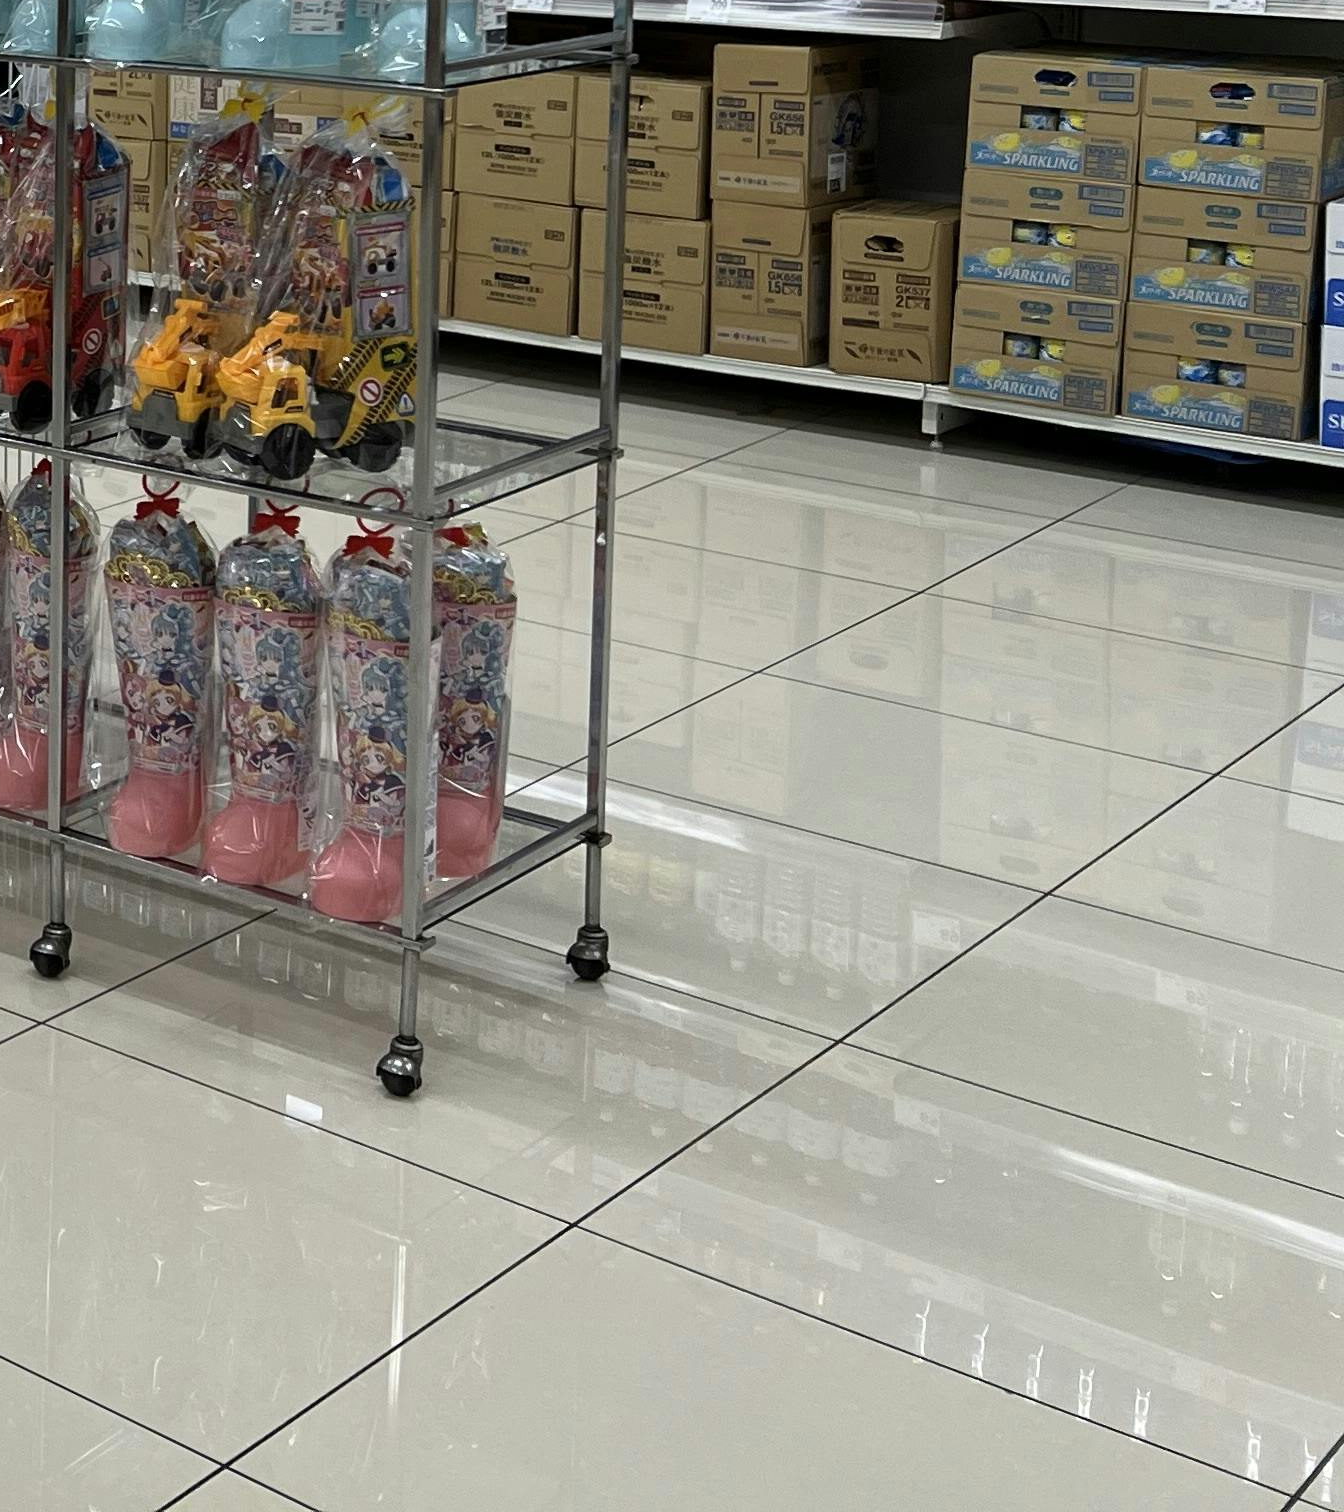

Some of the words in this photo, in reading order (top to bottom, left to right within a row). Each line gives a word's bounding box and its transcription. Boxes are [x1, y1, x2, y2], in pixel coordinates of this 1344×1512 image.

[1003, 151, 1080, 172] SPARKLING
[1180, 169, 1260, 191] SPARKLING
[995, 265, 1071, 287] SPARKLING
[1168, 286, 1249, 309] SPARKLING
[984, 378, 1058, 401] SPARKLING
[1160, 404, 1241, 428] SPARKLING
